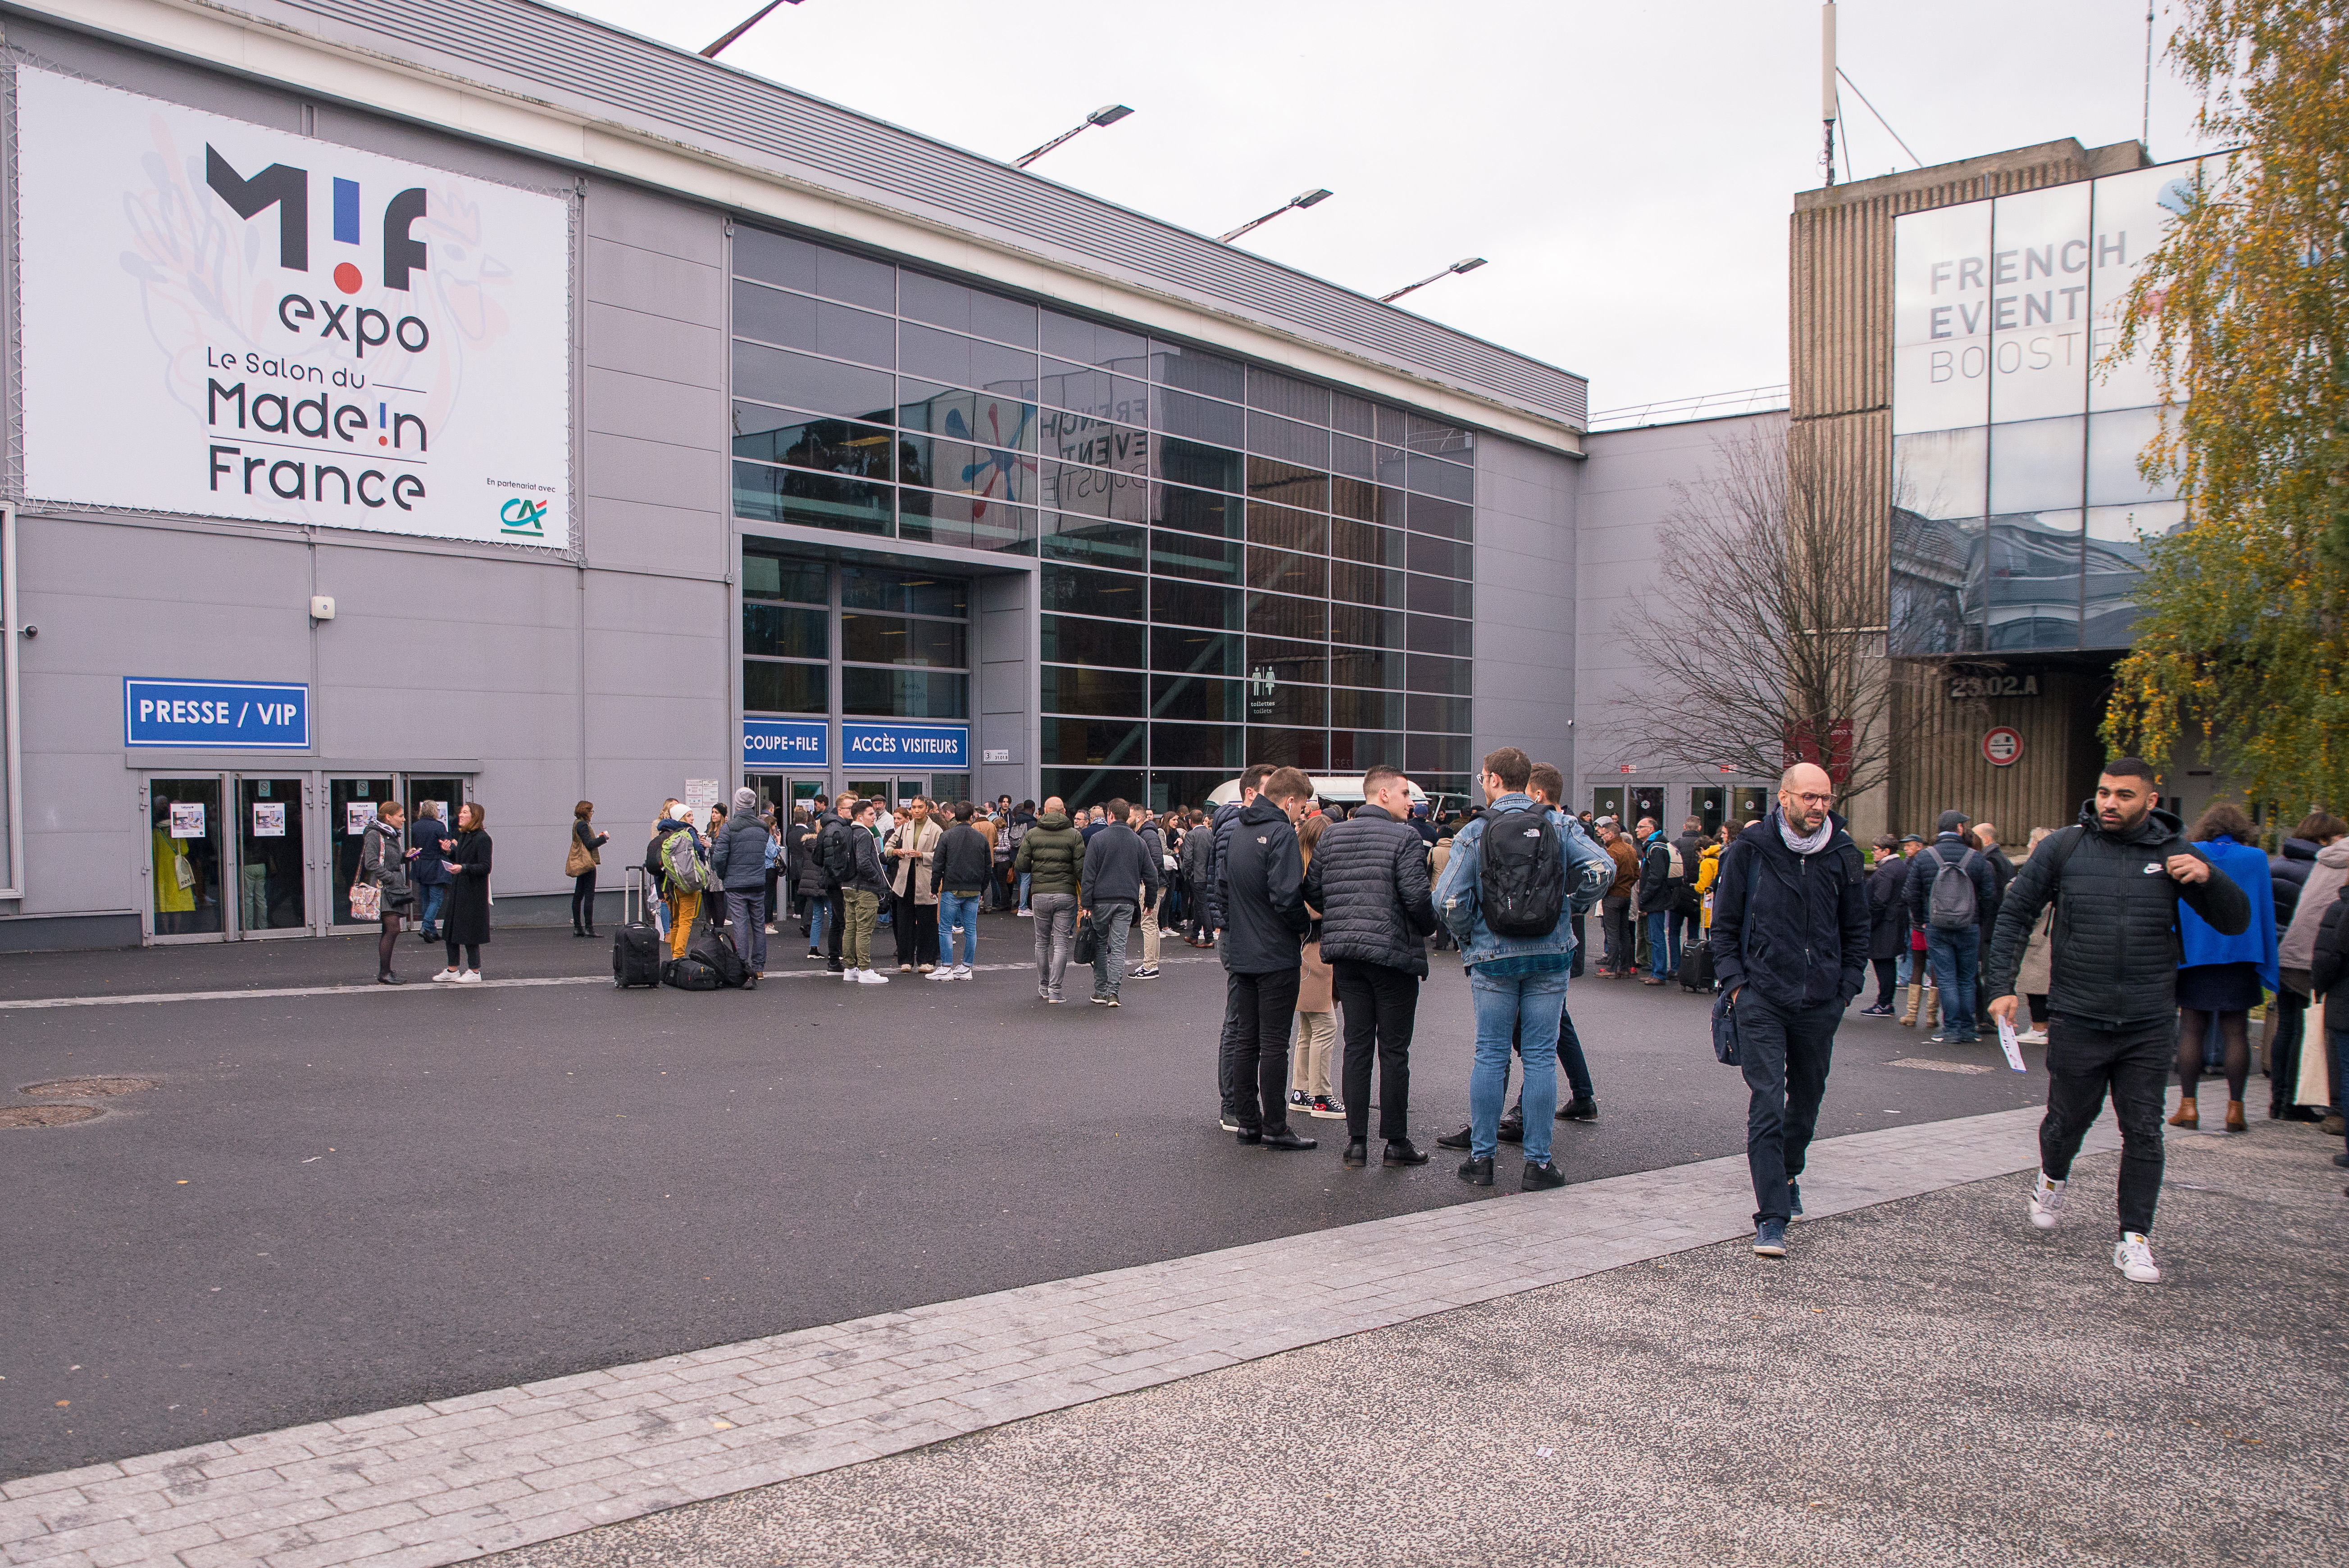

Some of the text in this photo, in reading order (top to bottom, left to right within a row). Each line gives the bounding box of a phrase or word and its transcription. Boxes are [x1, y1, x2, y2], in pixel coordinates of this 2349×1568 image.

[1930, 231, 2126, 295] FRENCH
[279, 294, 429, 359] expo
[1930, 286, 2086, 341] EVENT
[208, 347, 365, 389] Le Salon du
[209, 445, 426, 511] France
[497, 480, 537, 491] partenariat
[141, 700, 297, 728] PRESSE / VIP
[744, 735, 819, 751] COUPE-FILE
[852, 733, 958, 754] ACCÈS VISITEURS
